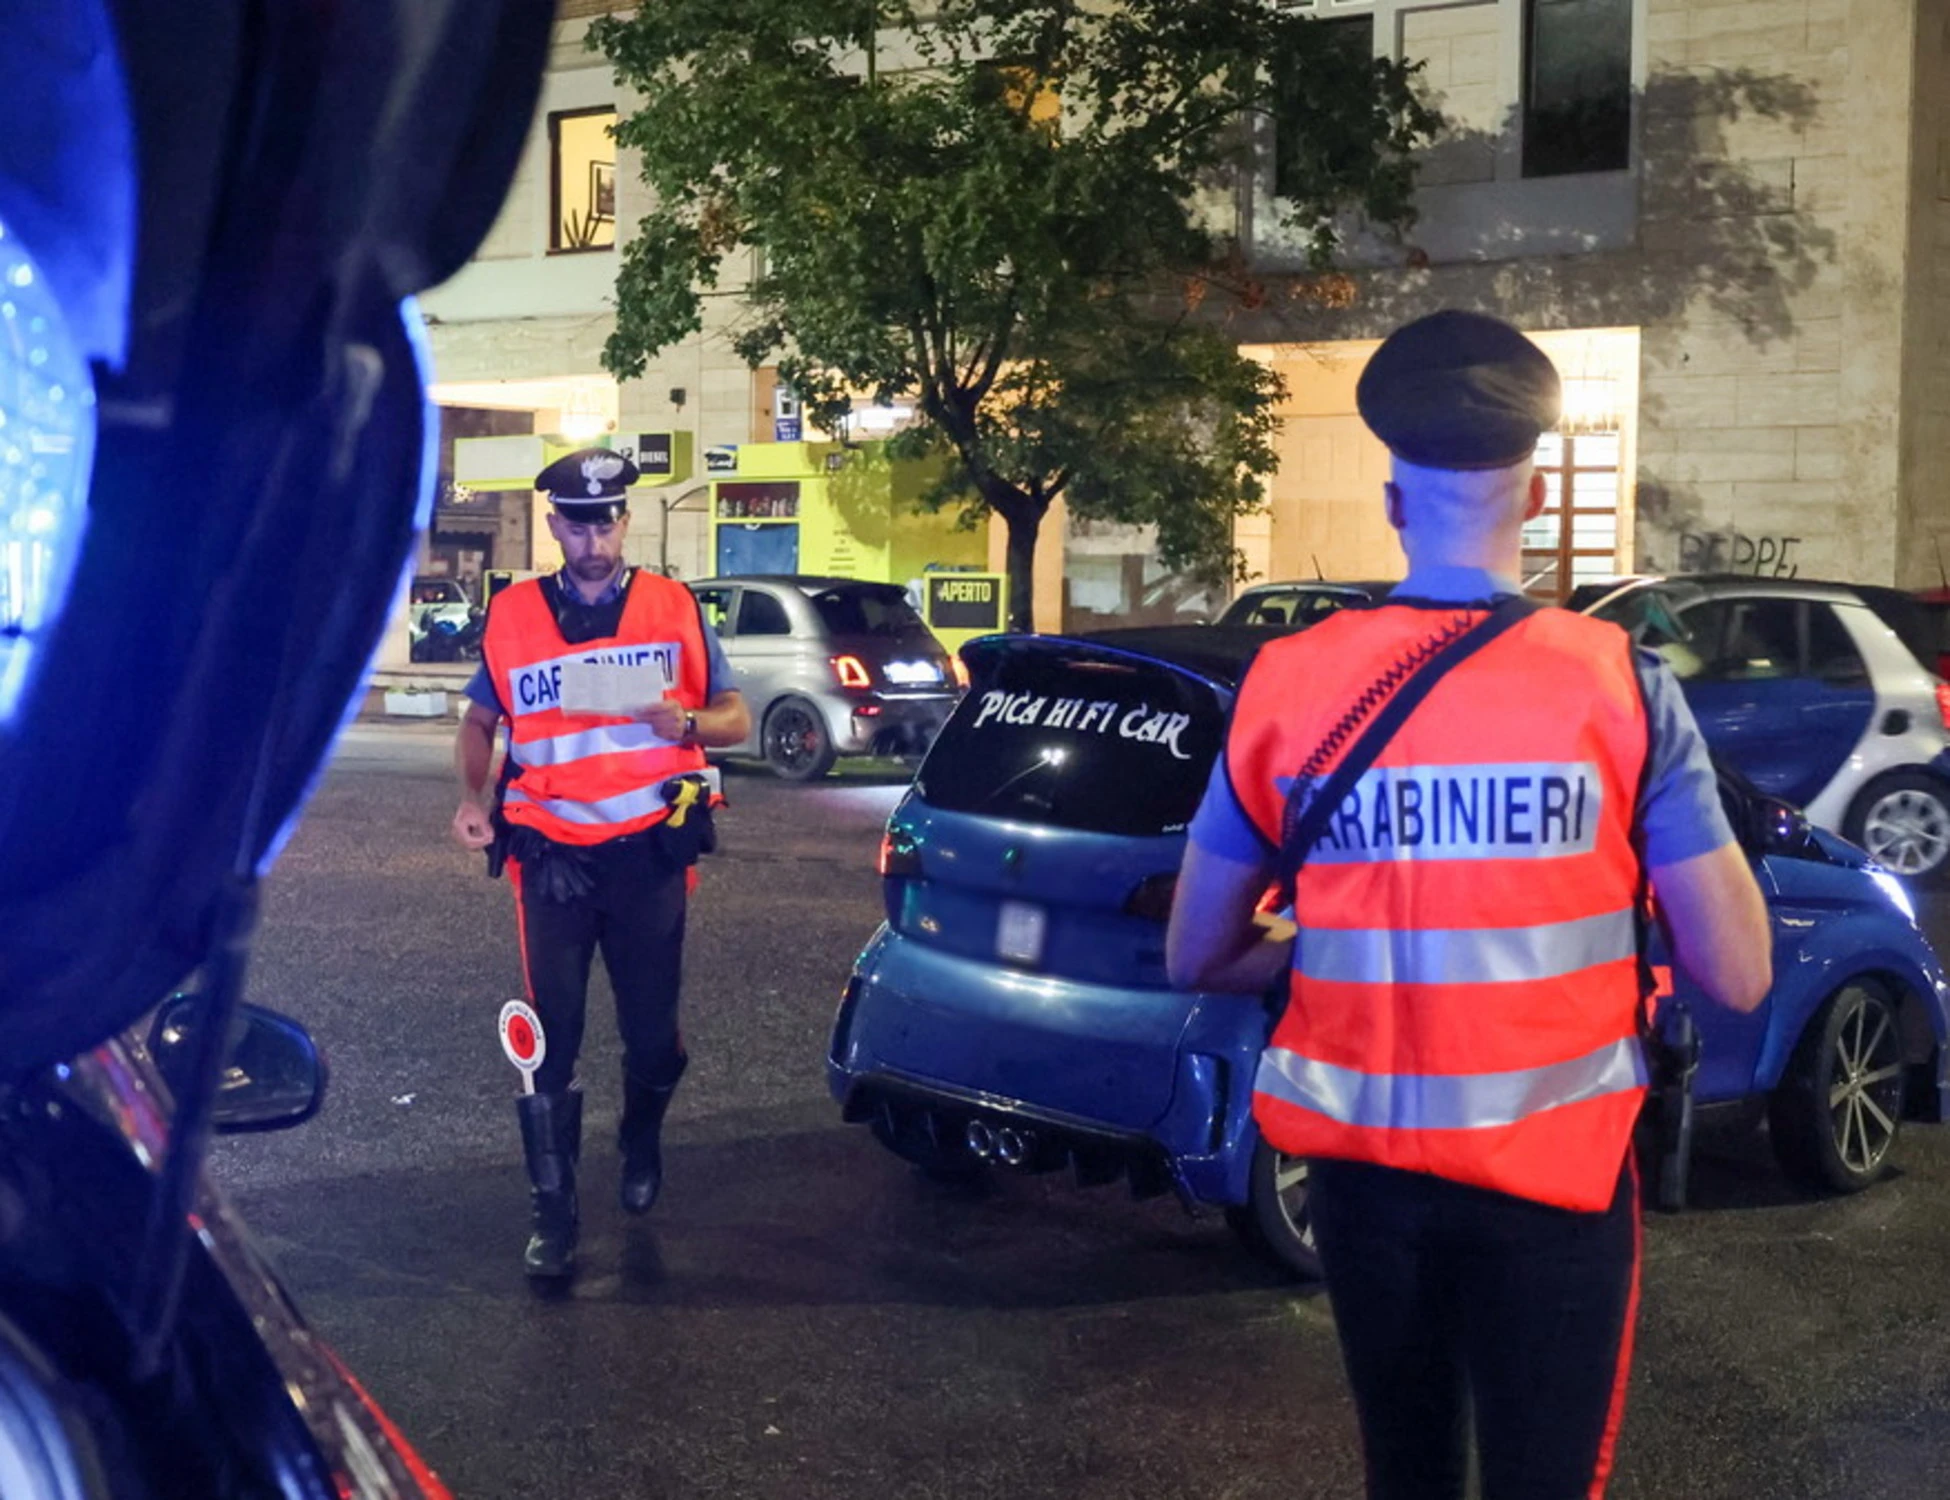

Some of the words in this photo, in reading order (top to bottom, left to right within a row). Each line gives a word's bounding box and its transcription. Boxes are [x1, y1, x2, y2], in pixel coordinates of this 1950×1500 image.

[939, 581, 992, 603] APERTO
[972, 689, 1048, 729] PICA
[1119, 702, 1191, 760] CAR
[1309, 775, 1587, 852] RABINIERI
